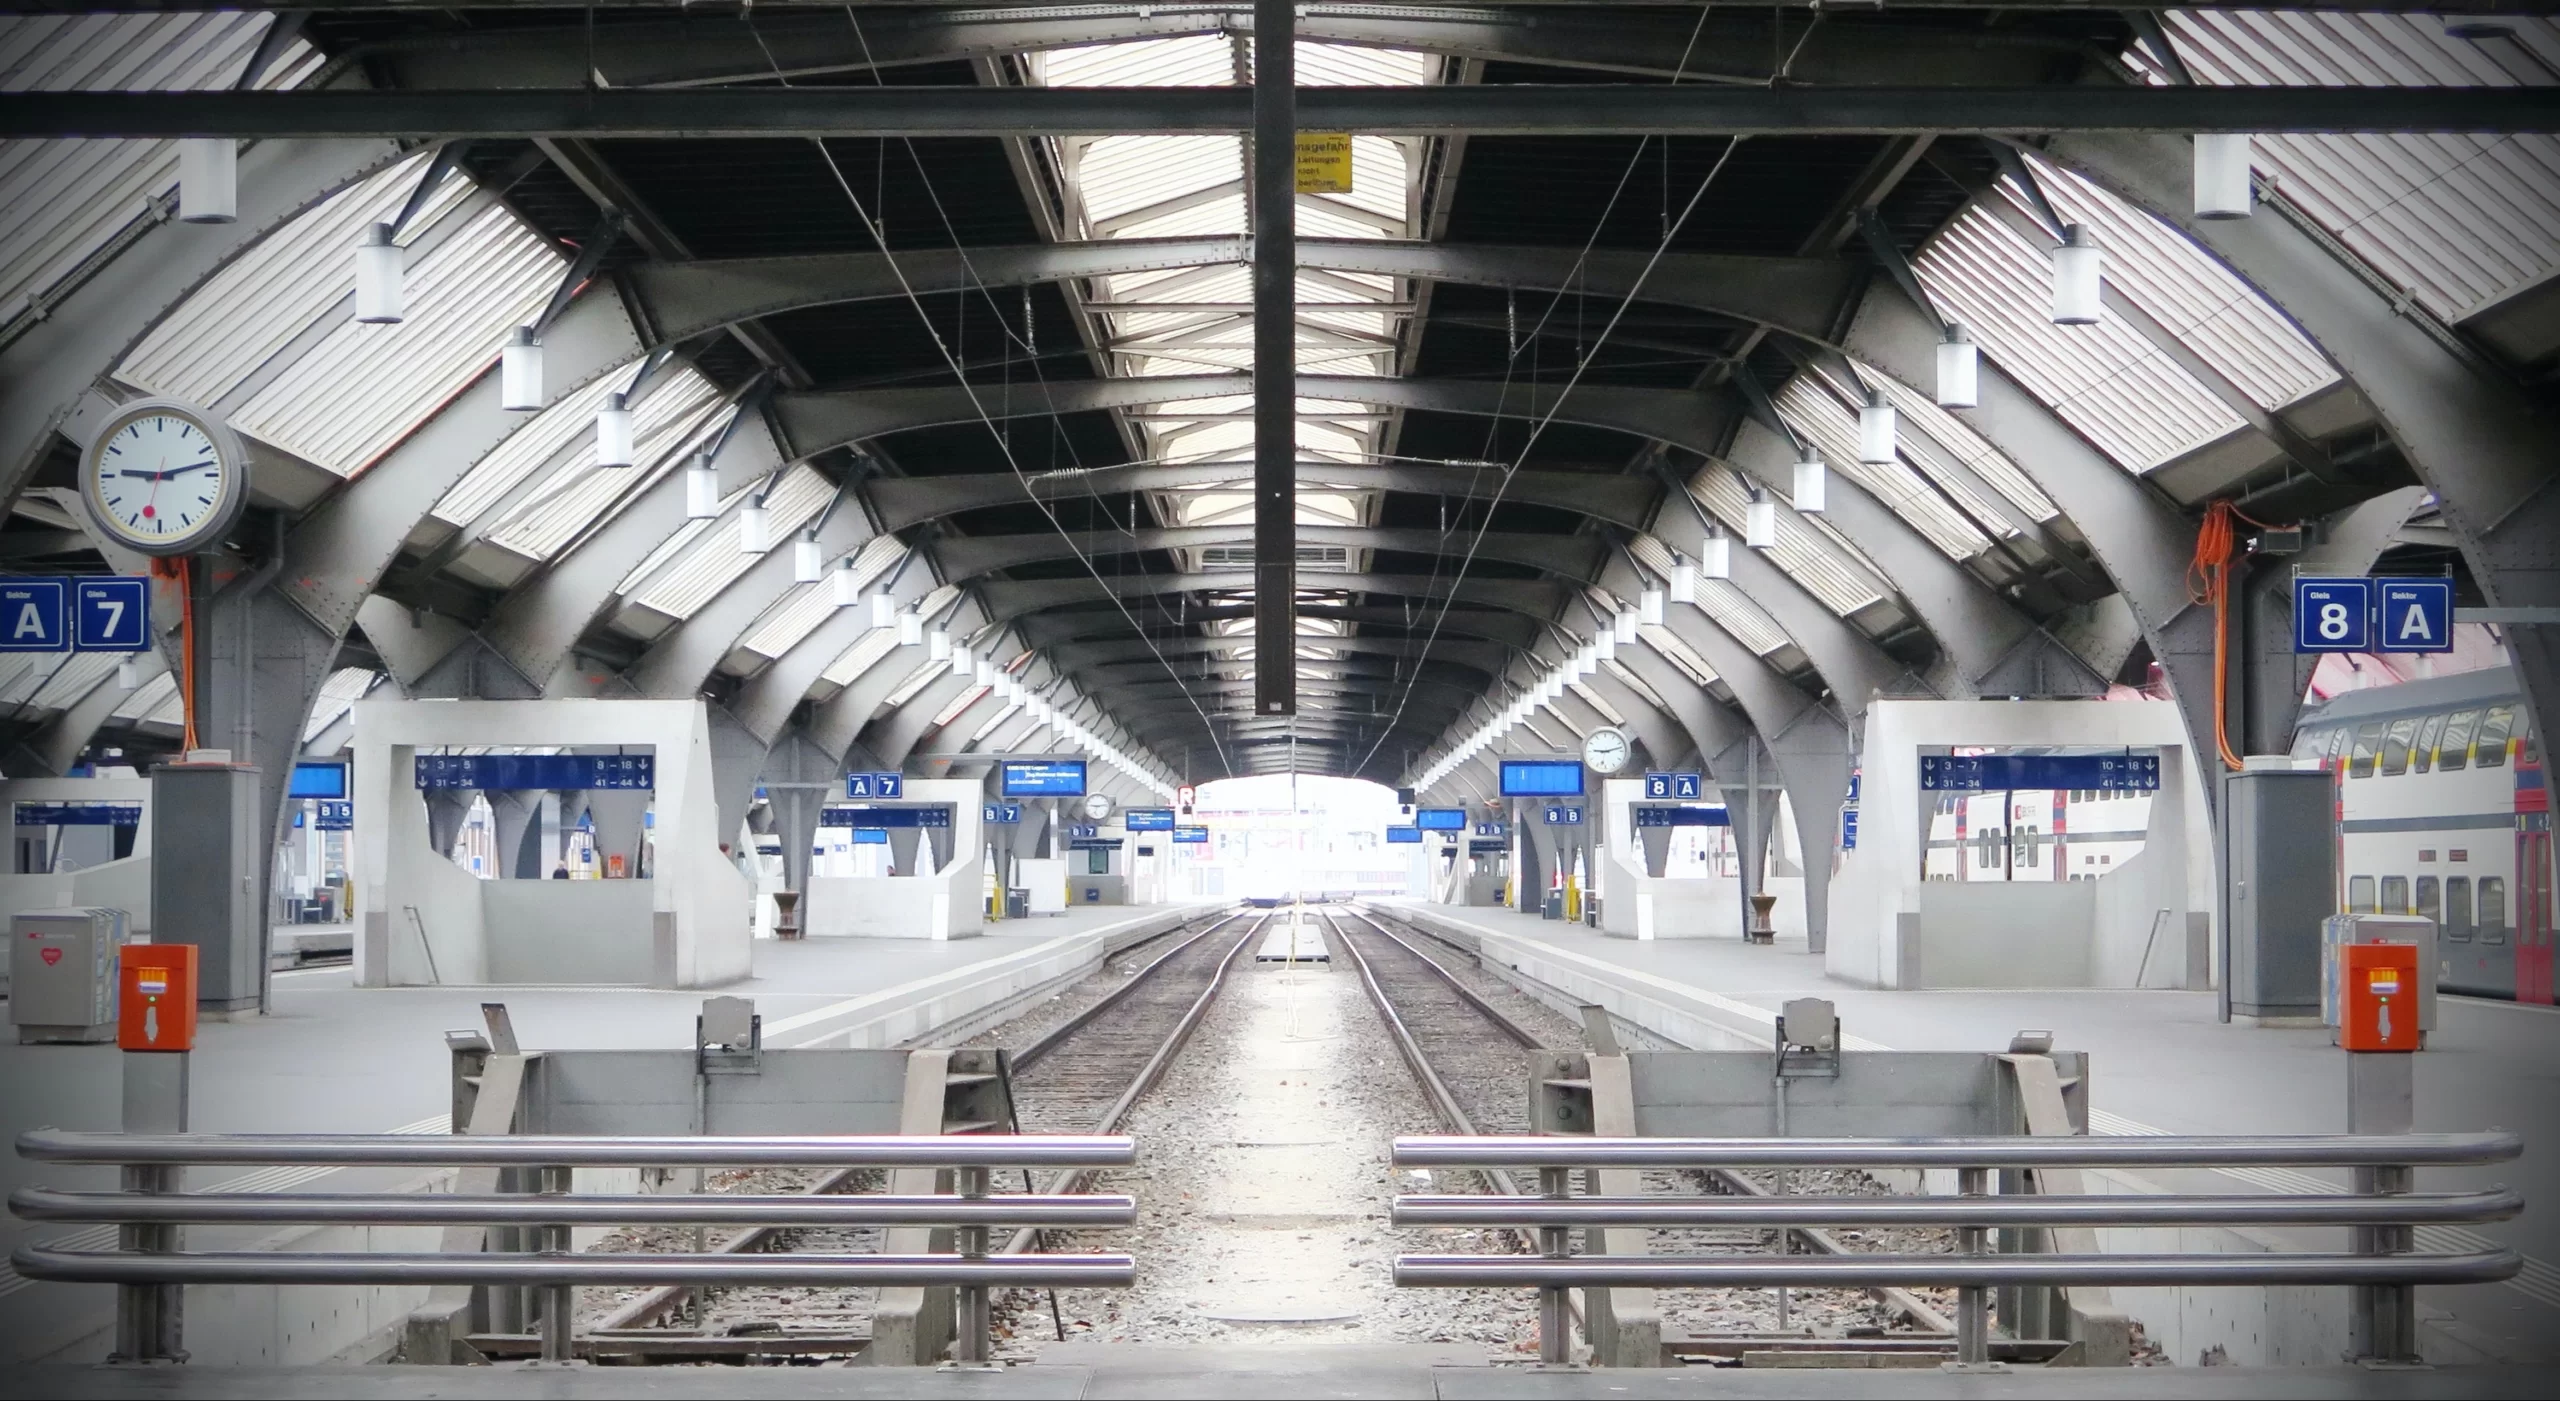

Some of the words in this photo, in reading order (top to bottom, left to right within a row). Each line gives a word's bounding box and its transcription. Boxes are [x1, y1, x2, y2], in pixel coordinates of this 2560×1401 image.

[2310, 591, 2331, 600] Gleis
[2391, 591, 2418, 600] Sektor
[13, 602, 46, 639] A
[97, 601, 125, 638] 7
[2319, 603, 2349, 640] 8
[2399, 603, 2432, 640] A
[437, 760, 445, 770] 3
[463, 760, 471, 770] 5
[621, 760, 633, 770] 18
[1944, 761, 1952, 771] 3
[1971, 761, 1978, 771] 7
[2102, 761, 2114, 771] 10
[2128, 761, 2139, 771] 18
[436, 778, 447, 787] 31
[460, 778, 473, 787] 34
[595, 778, 606, 787] 41
[620, 778, 633, 787] 44
[854, 780, 867, 795] A
[883, 780, 894, 795] 7
[1681, 781, 1694, 795] A
[1943, 779, 1954, 788] 31
[1968, 779, 1980, 788] 34
[2102, 779, 2113, 788] 41
[2127, 779, 2140, 788] 44
[1653, 781, 1665, 796] 8
[1180, 787, 1194, 804] R
[321, 806, 331, 817] B
[341, 806, 351, 817] 5
[986, 809, 995, 820] B
[1006, 809, 1015, 821] 7
[1549, 810, 1558, 822] 8
[1569, 810, 1578, 822] B
[1072, 828, 1080, 837] B
[1088, 828, 1095, 837] 7
[1479, 826, 1486, 835] 8
[1493, 826, 1500, 835] B
